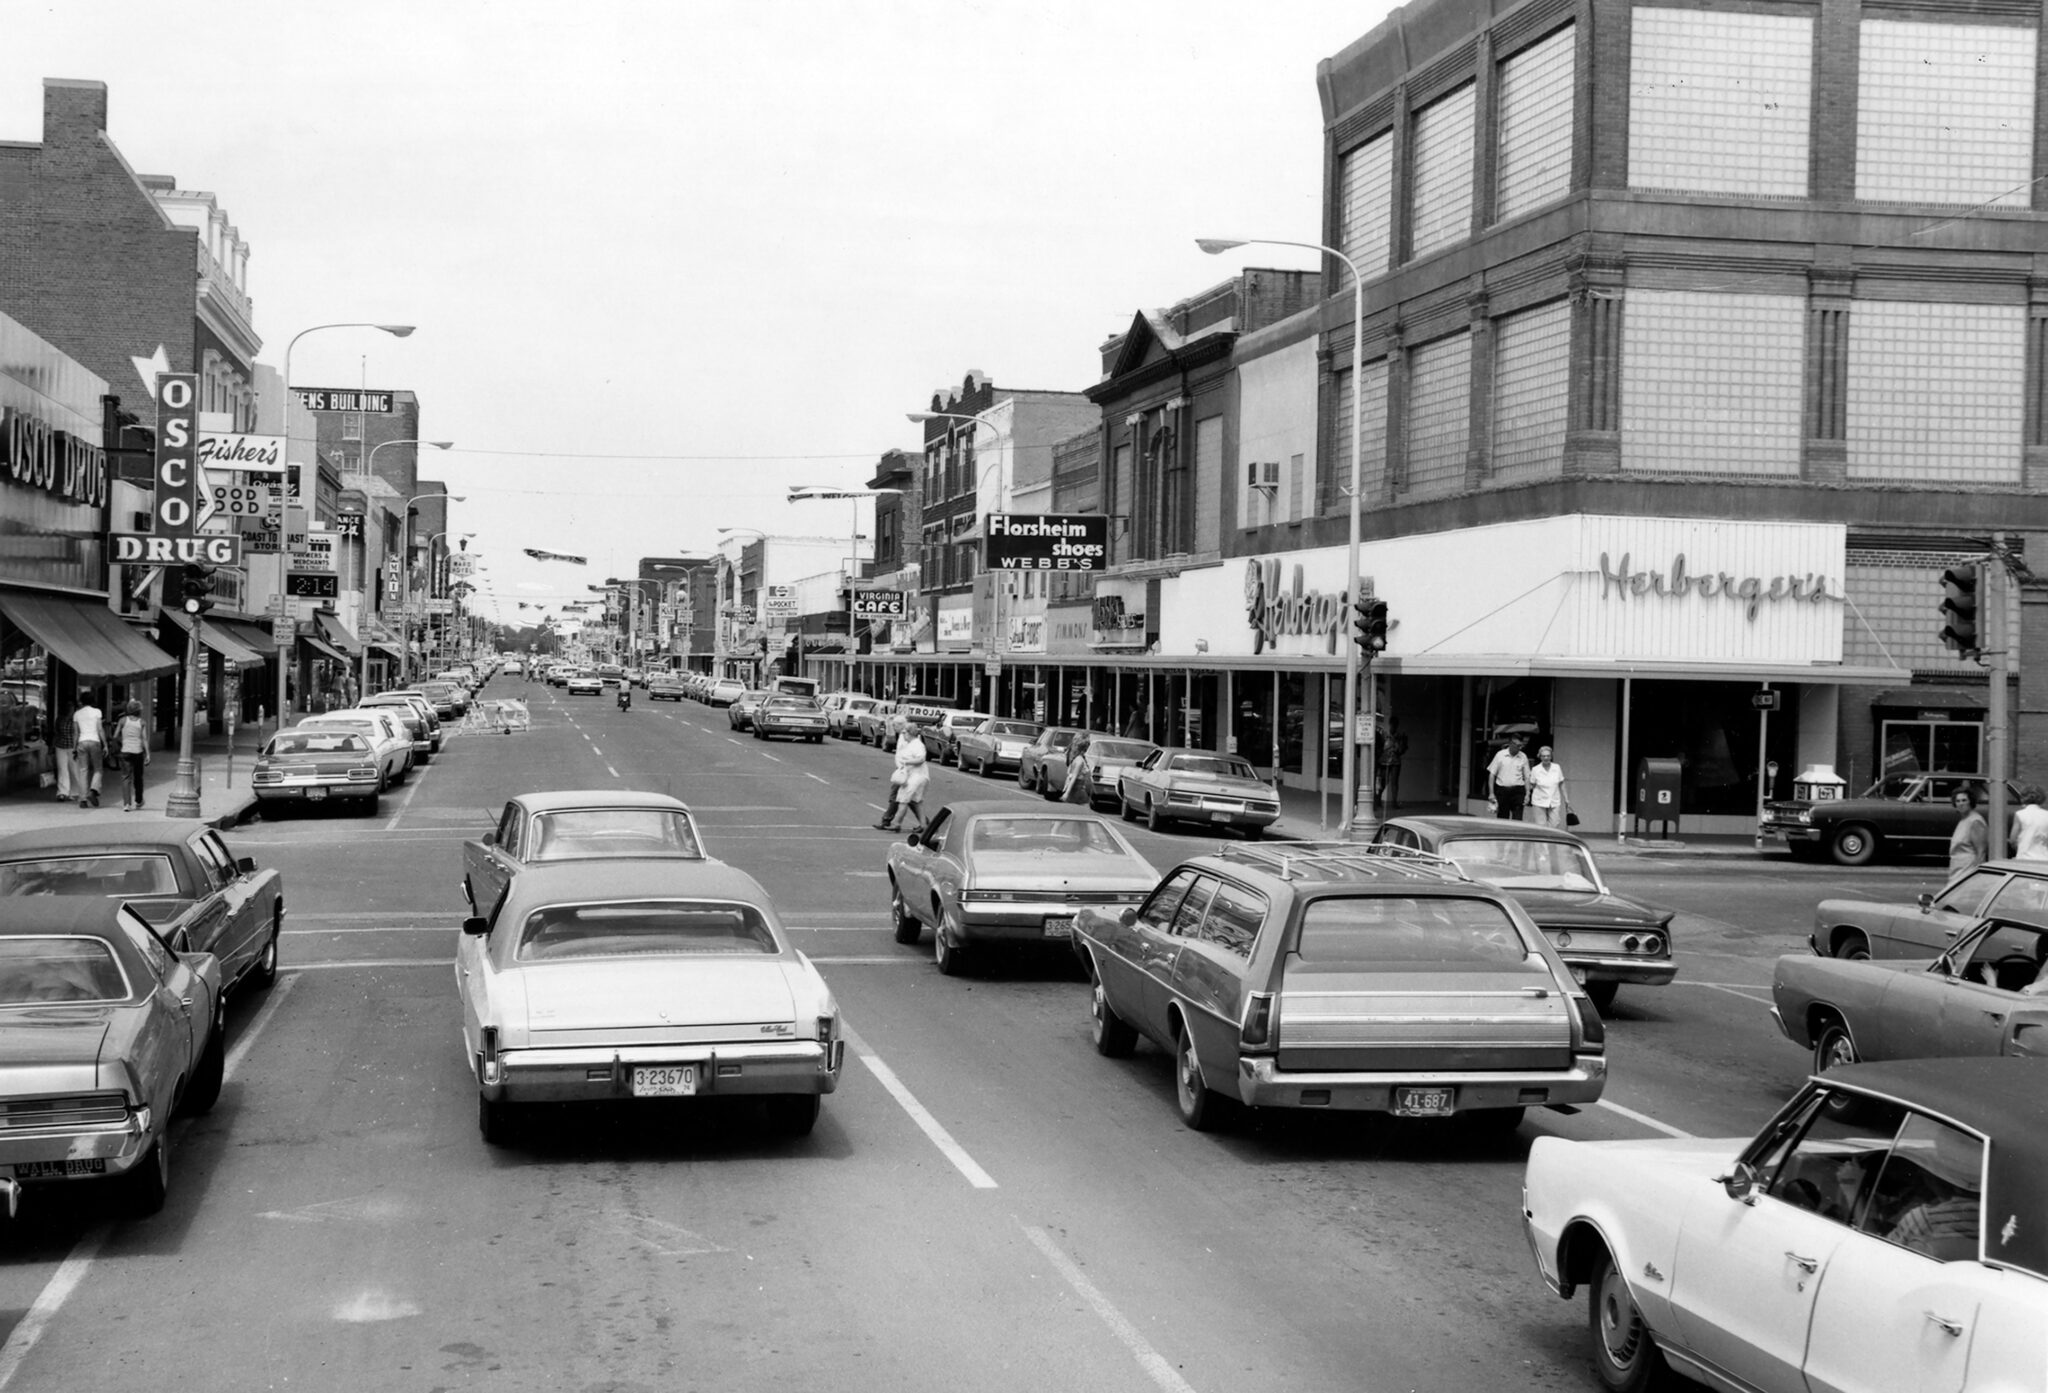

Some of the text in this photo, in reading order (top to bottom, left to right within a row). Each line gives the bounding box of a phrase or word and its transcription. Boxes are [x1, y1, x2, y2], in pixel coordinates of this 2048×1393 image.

[330, 393, 388, 412] BUILDING
[9, 411, 108, 508] OSCO DRUG
[160, 380, 192, 526] OSCO
[198, 437, 278, 465] Fisher's
[989, 515, 1087, 537] Florsheim
[241, 531, 266, 542] COAST
[116, 536, 233, 564] DRUG
[1052, 538, 1104, 557] shoes
[1001, 557, 1093, 570] WEBB'S
[297, 578, 334, 594] 2:14
[1600, 552, 1845, 622] Herberger's
[859, 592, 900, 600] VIRGINIA
[854, 600, 900, 613] CAFE
[17, 1159, 103, 1174] WALL DRUG
